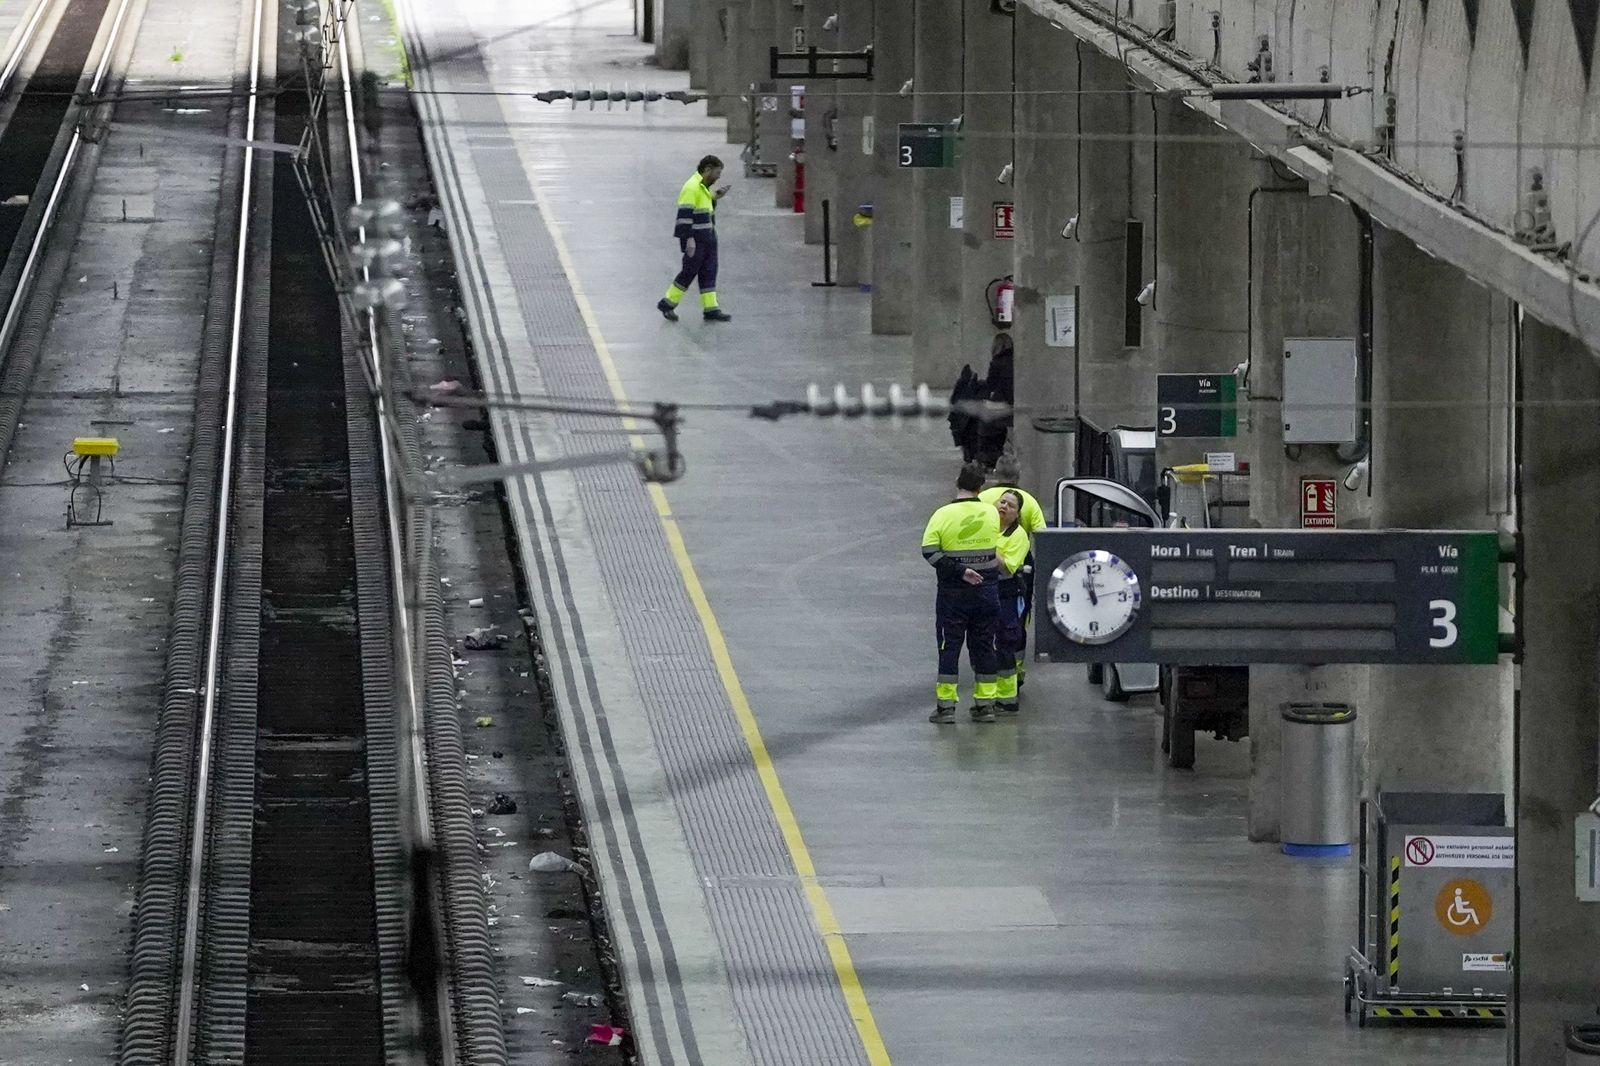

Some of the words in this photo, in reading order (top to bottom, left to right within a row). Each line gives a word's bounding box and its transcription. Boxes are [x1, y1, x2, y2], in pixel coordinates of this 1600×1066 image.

[901, 145, 912, 165] 3
[1199, 379, 1211, 387] Vía
[1161, 407, 1177, 434] 3
[1304, 517, 1334, 525] EXTINTOR
[1151, 544, 1181, 557] Hora
[1196, 549, 1214, 557] TIME
[1229, 545, 1257, 557] Tren
[1273, 549, 1295, 557] TRAIN
[1438, 544, 1458, 557] Vía
[1060, 592, 1070, 603] 9
[1151, 585, 1199, 598] Destino
[1215, 590, 1261, 598] DESTINATION
[1089, 621, 1099, 632] 6
[1429, 599, 1458, 648] 3
